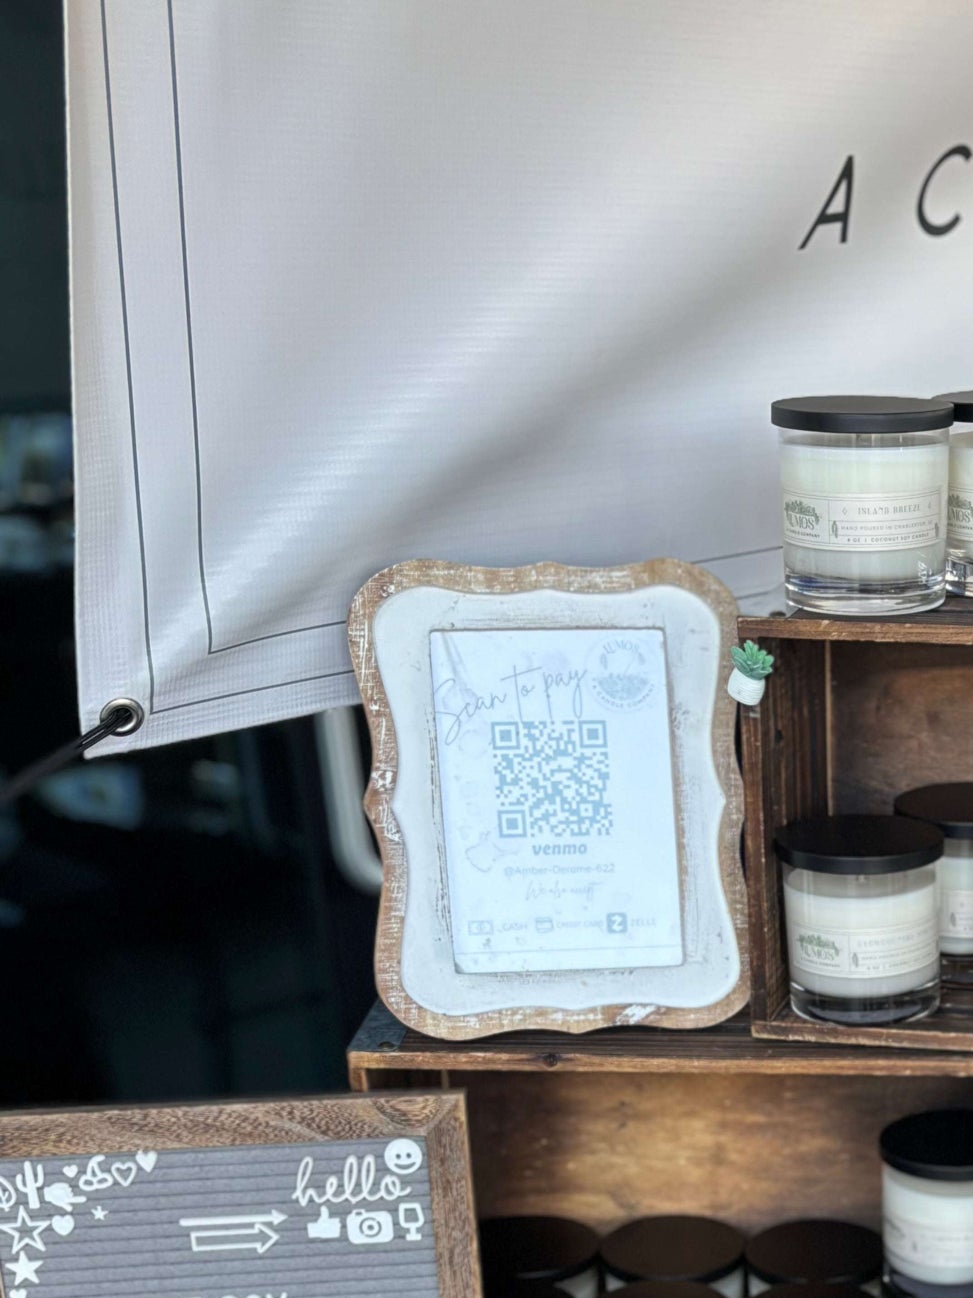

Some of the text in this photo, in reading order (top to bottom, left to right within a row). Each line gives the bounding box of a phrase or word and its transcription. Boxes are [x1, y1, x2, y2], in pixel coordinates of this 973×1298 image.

[799, 154, 855, 250] A
[434, 678, 507, 746] Scan
[501, 665, 542, 724] to
[543, 668, 587, 722] pay
[532, 843, 587, 855] venmo
[292, 1153, 412, 1206] hello
